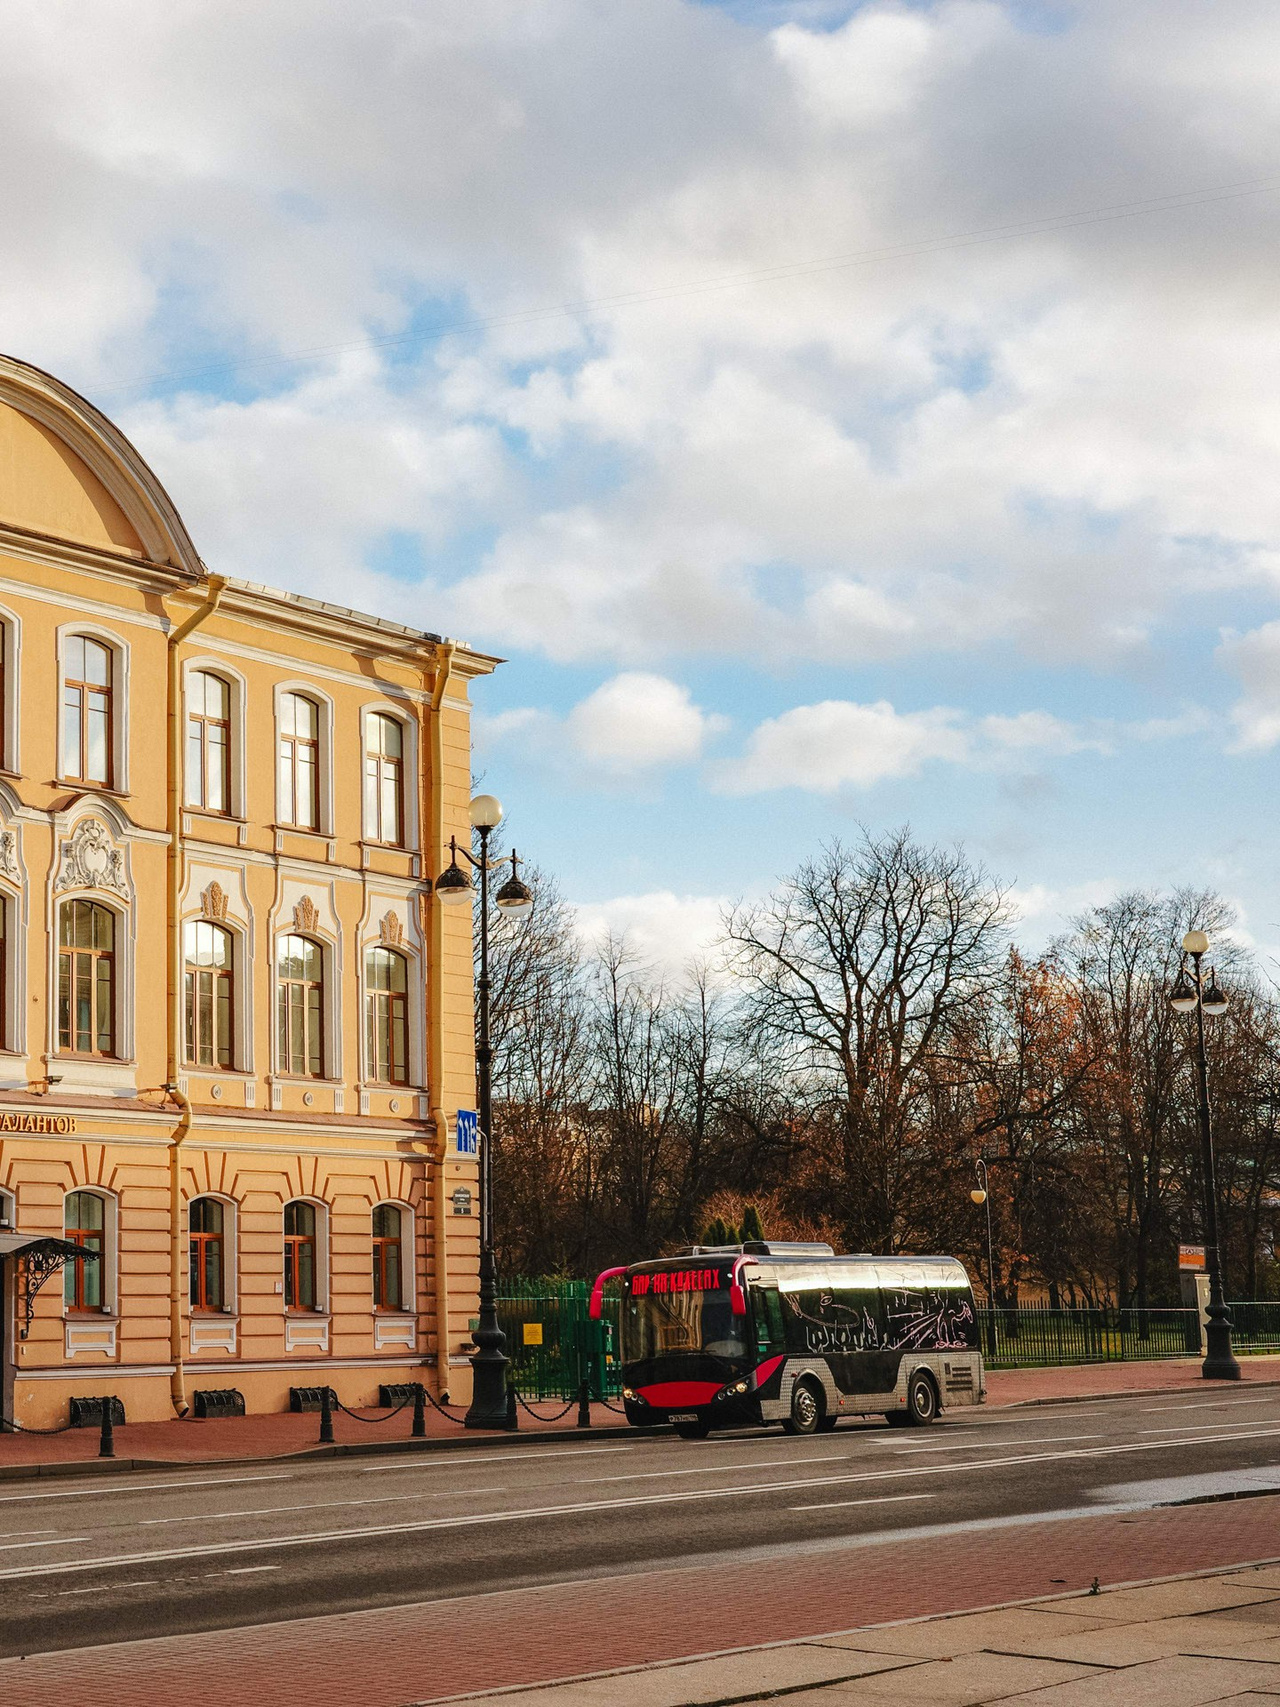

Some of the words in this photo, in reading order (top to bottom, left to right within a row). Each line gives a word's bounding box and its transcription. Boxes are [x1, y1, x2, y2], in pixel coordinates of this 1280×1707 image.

[632, 1275, 650, 1295] БАР
[653, 1273, 668, 1293] НА
[670, 1269, 720, 1291] КОЛЕСАХ
